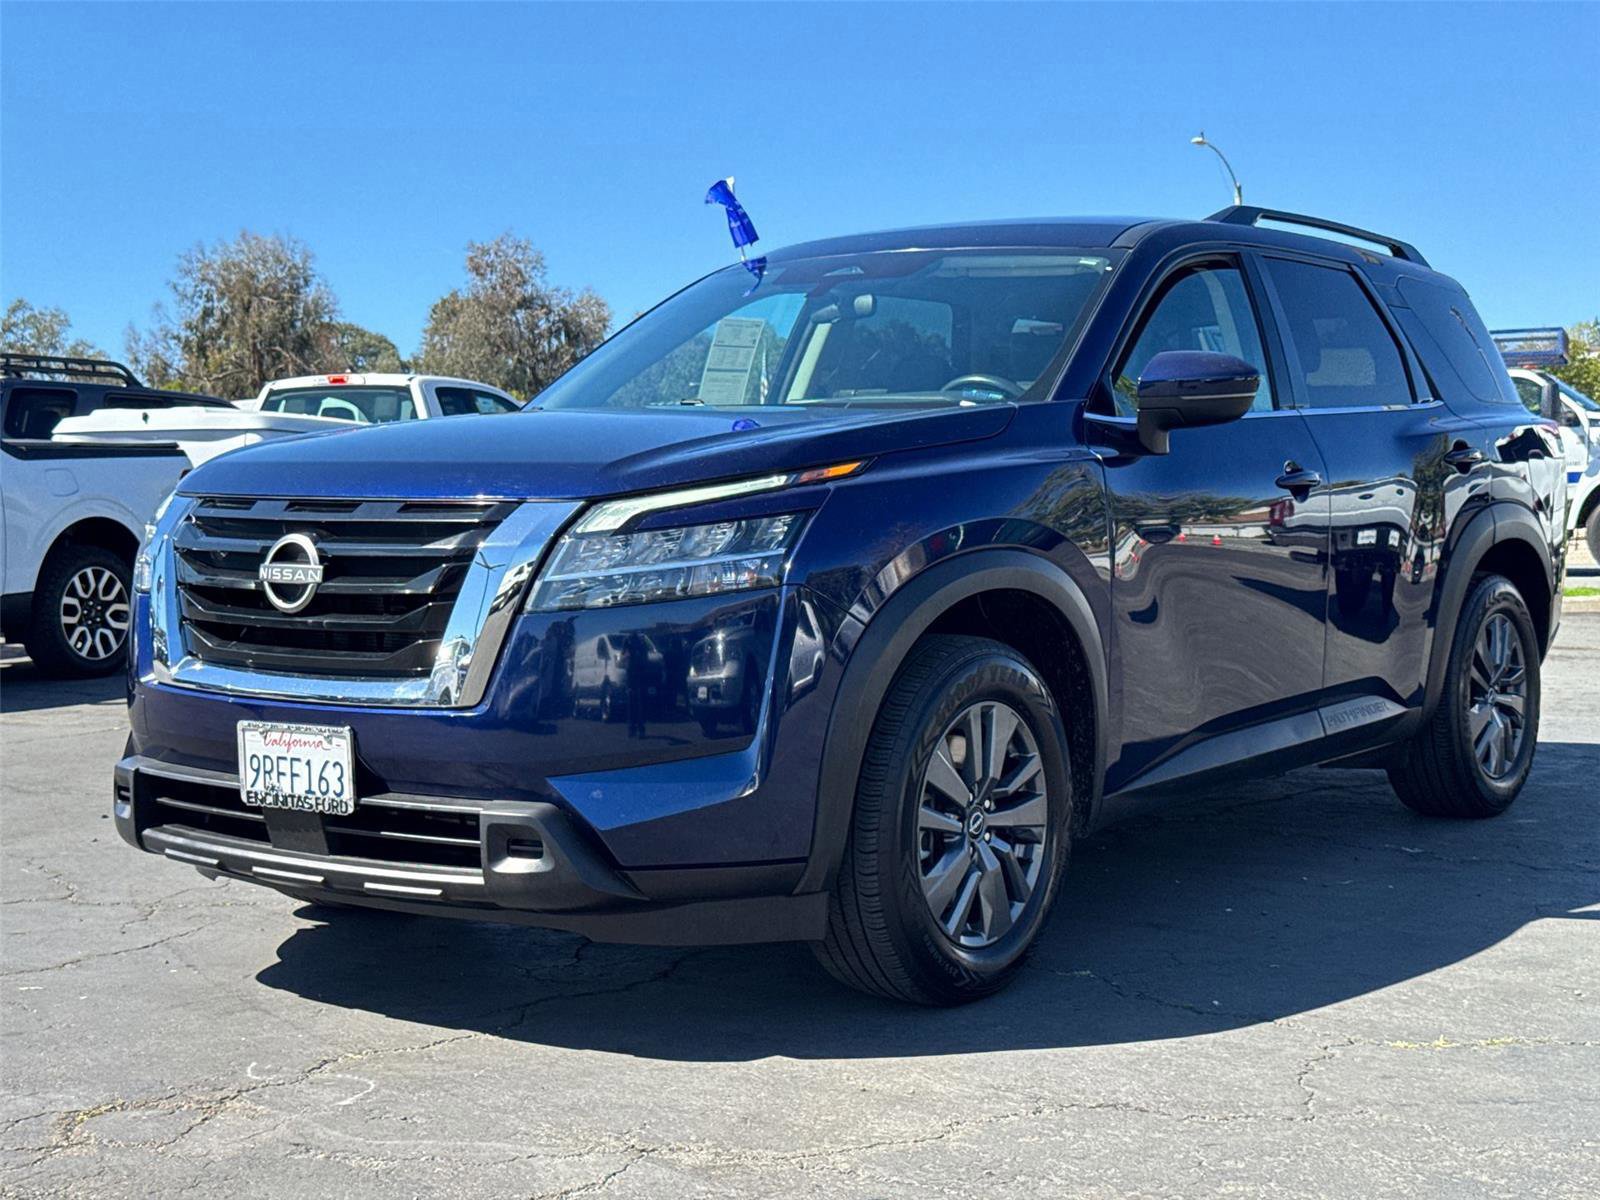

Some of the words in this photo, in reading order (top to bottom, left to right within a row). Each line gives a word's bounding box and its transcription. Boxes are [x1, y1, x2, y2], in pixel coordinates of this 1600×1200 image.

[260, 567, 321, 581] NISSAN
[263, 731, 331, 753] California
[246, 791, 313, 810] ENCINITAS
[315, 797, 349, 814] FORD
